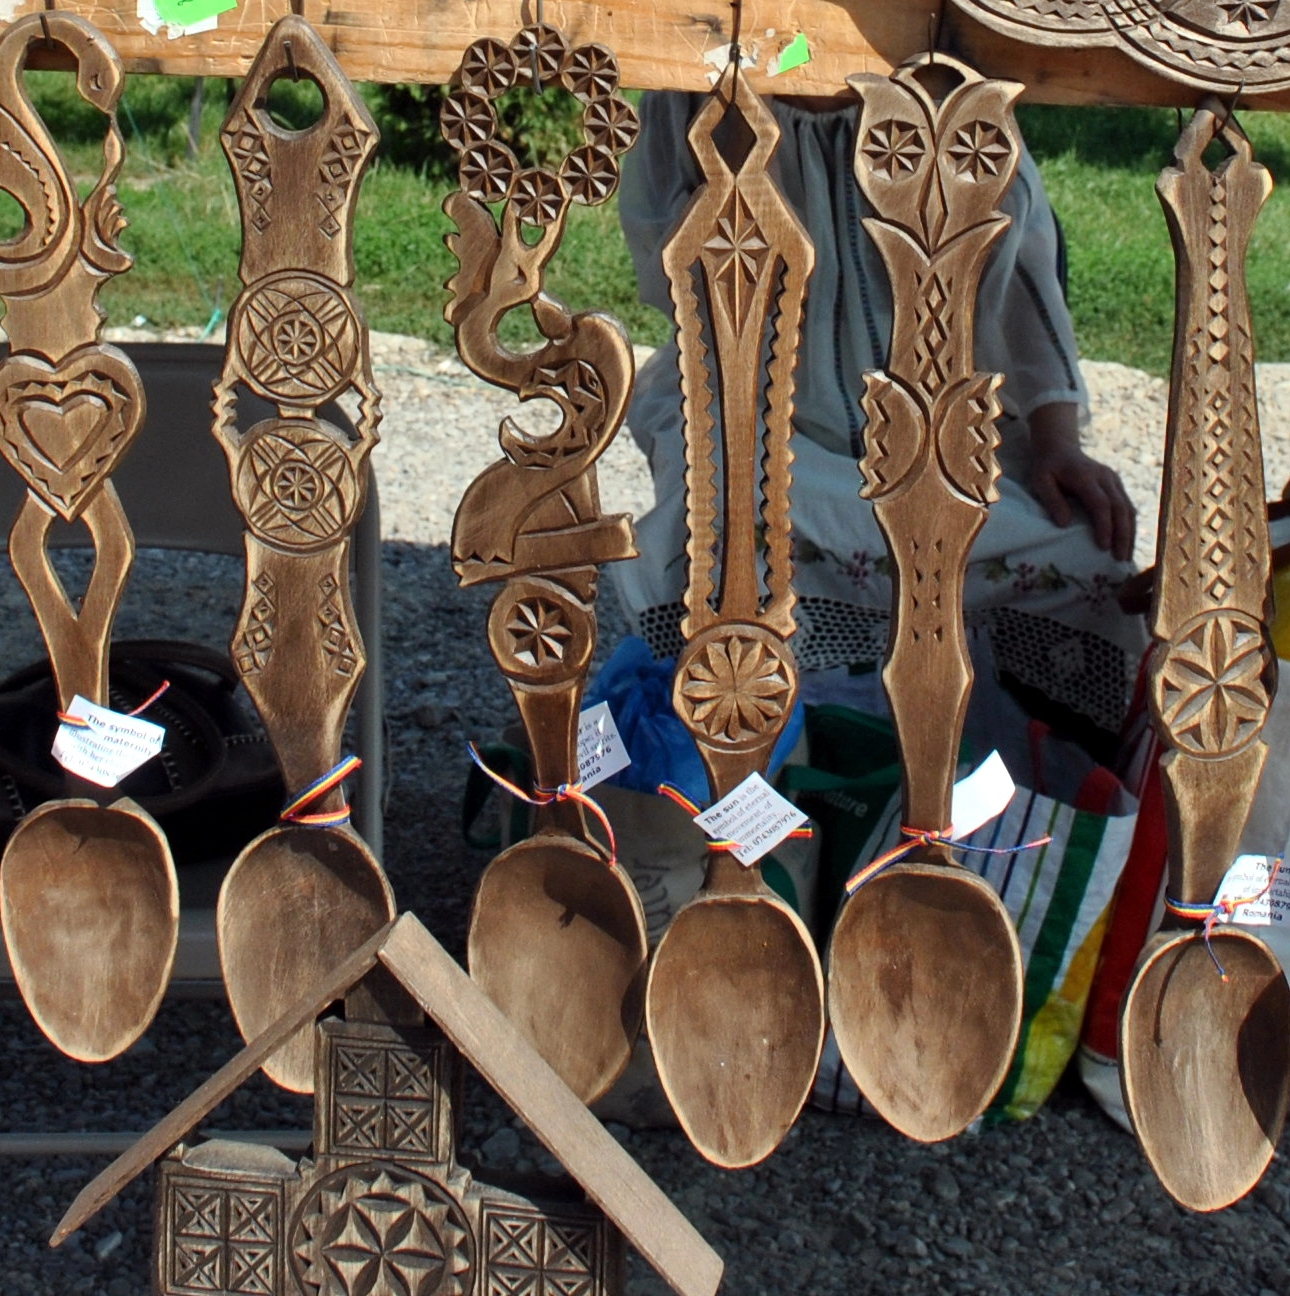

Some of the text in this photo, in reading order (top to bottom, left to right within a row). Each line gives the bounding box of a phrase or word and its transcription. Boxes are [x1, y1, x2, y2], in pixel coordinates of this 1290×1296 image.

[87, 714, 106, 727] The
[108, 724, 147, 740] symbol
[103, 734, 154, 756] maternity
[704, 783, 759, 825] The sun is the
[712, 788, 771, 835] symbol of eternal
[765, 800, 773, 811] of
[736, 811, 797, 858] Tel: 0743087976
[1242, 909, 1283, 921] Romania
